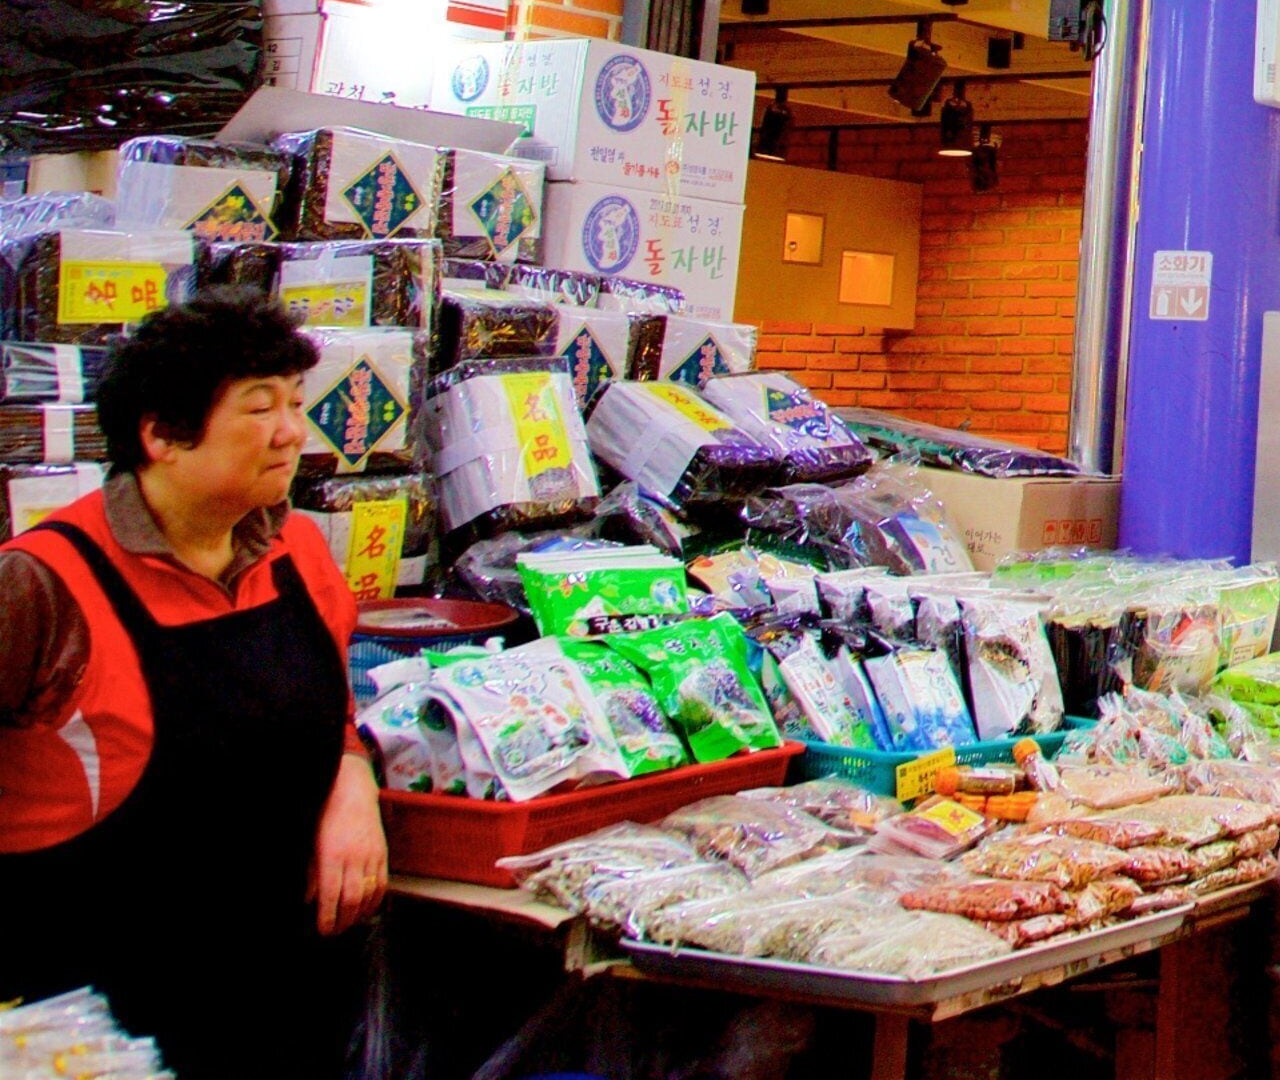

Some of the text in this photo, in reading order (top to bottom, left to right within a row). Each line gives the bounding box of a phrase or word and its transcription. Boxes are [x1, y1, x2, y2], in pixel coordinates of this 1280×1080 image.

[656, 98, 739, 147] 돌자반
[643, 239, 727, 280] 돌자반
[1158, 255, 1206, 273] 소화기
[522, 392, 559, 462] 名品
[352, 524, 387, 600] 名品
